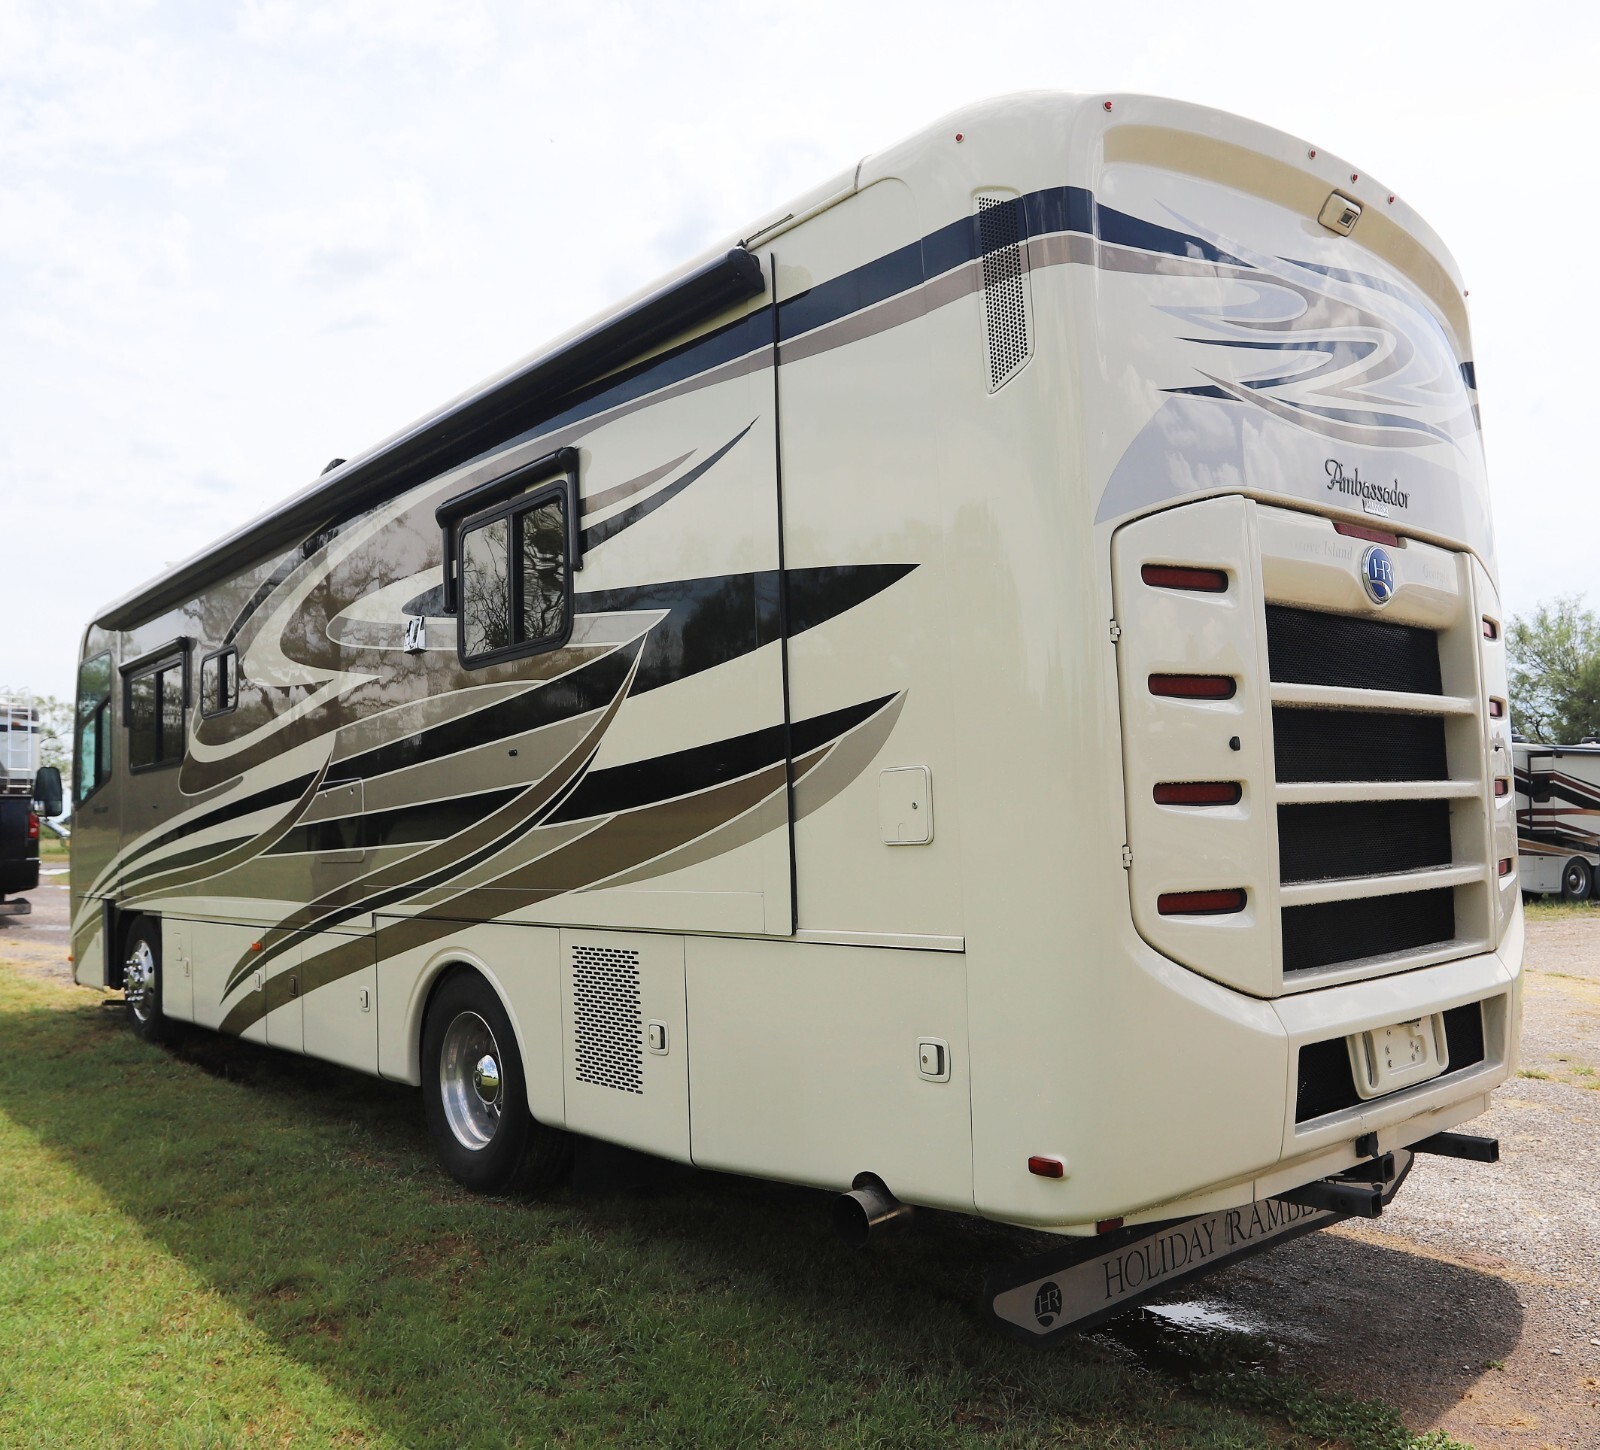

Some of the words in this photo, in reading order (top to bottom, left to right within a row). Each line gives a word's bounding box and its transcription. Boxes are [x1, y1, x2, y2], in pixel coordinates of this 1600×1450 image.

[1324, 458, 1411, 509] Ambassador
[1373, 558, 1393, 582] HR
[1102, 1218, 1217, 1300] HOLIDAY
[1226, 1200, 1322, 1246] RAMBL
[1035, 1288, 1061, 1316] HR
